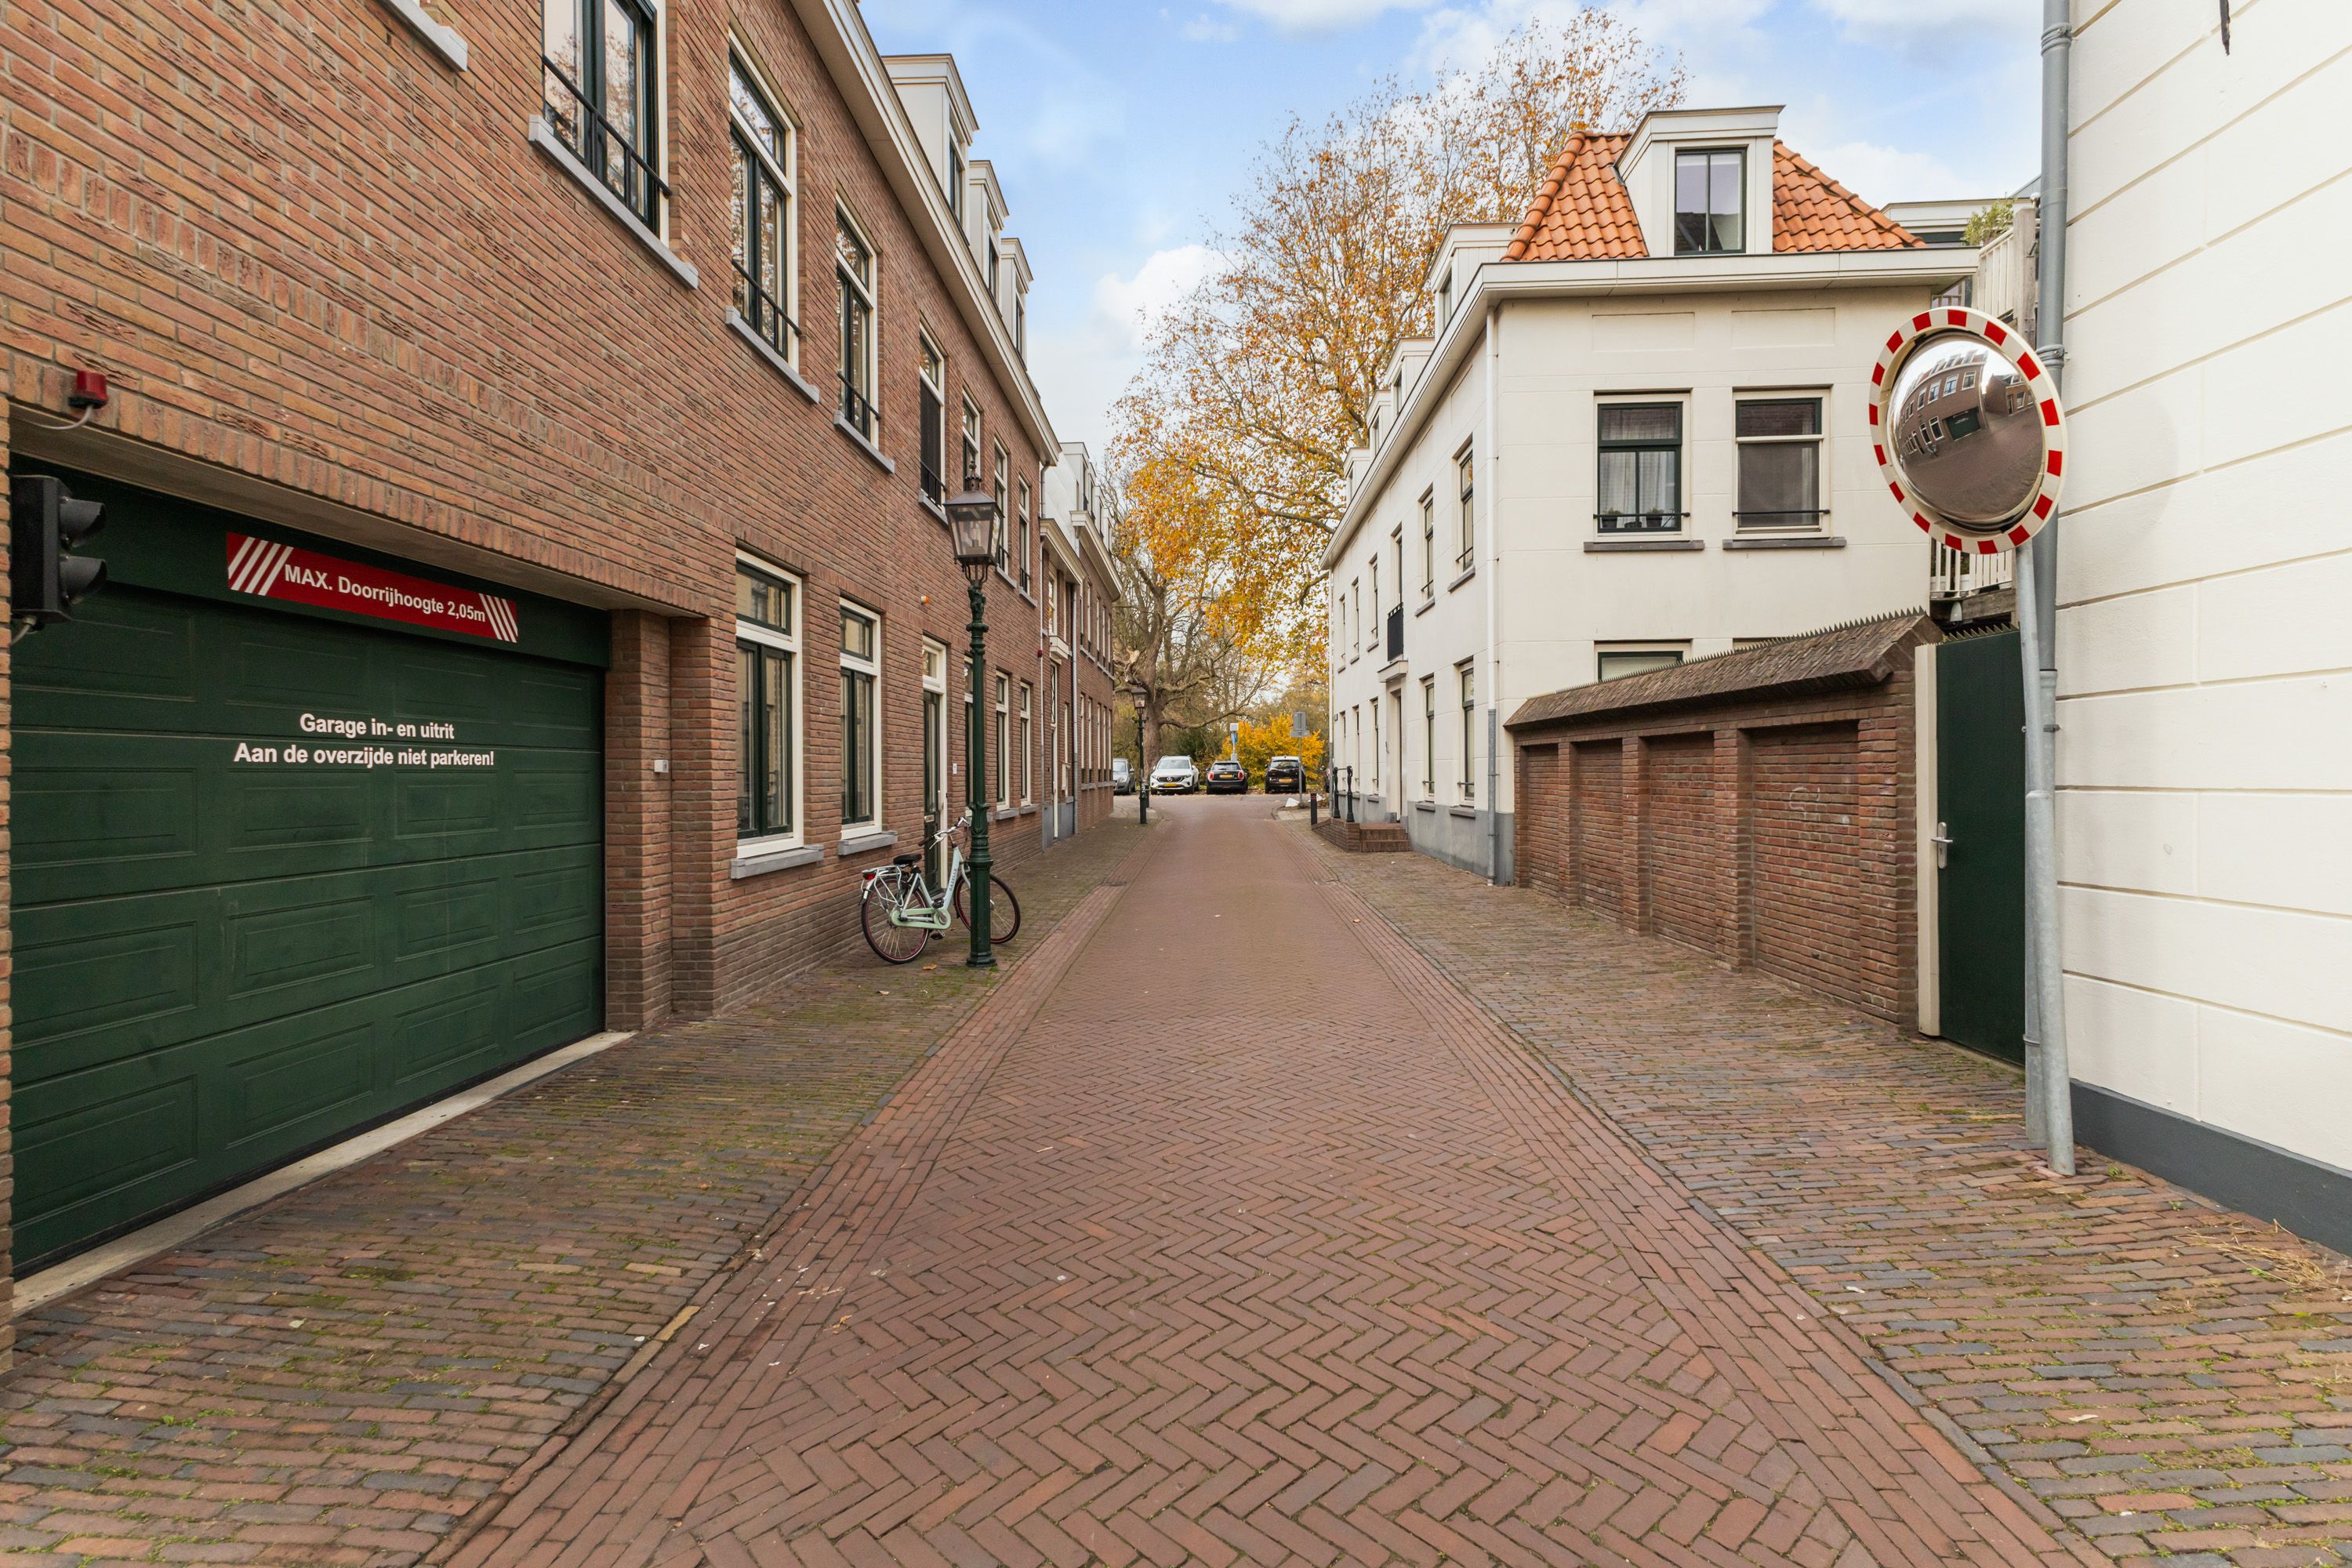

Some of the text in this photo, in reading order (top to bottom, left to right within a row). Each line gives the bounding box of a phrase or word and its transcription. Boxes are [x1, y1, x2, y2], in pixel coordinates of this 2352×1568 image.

[285, 564, 486, 622] MAX. Doorrijhoogte 2,05m
[299, 713, 455, 739] Garage in- en uitrit
[234, 742, 495, 768] Aan de overzijde niet parkeren!
[949, 868, 957, 891] GAZELLE
